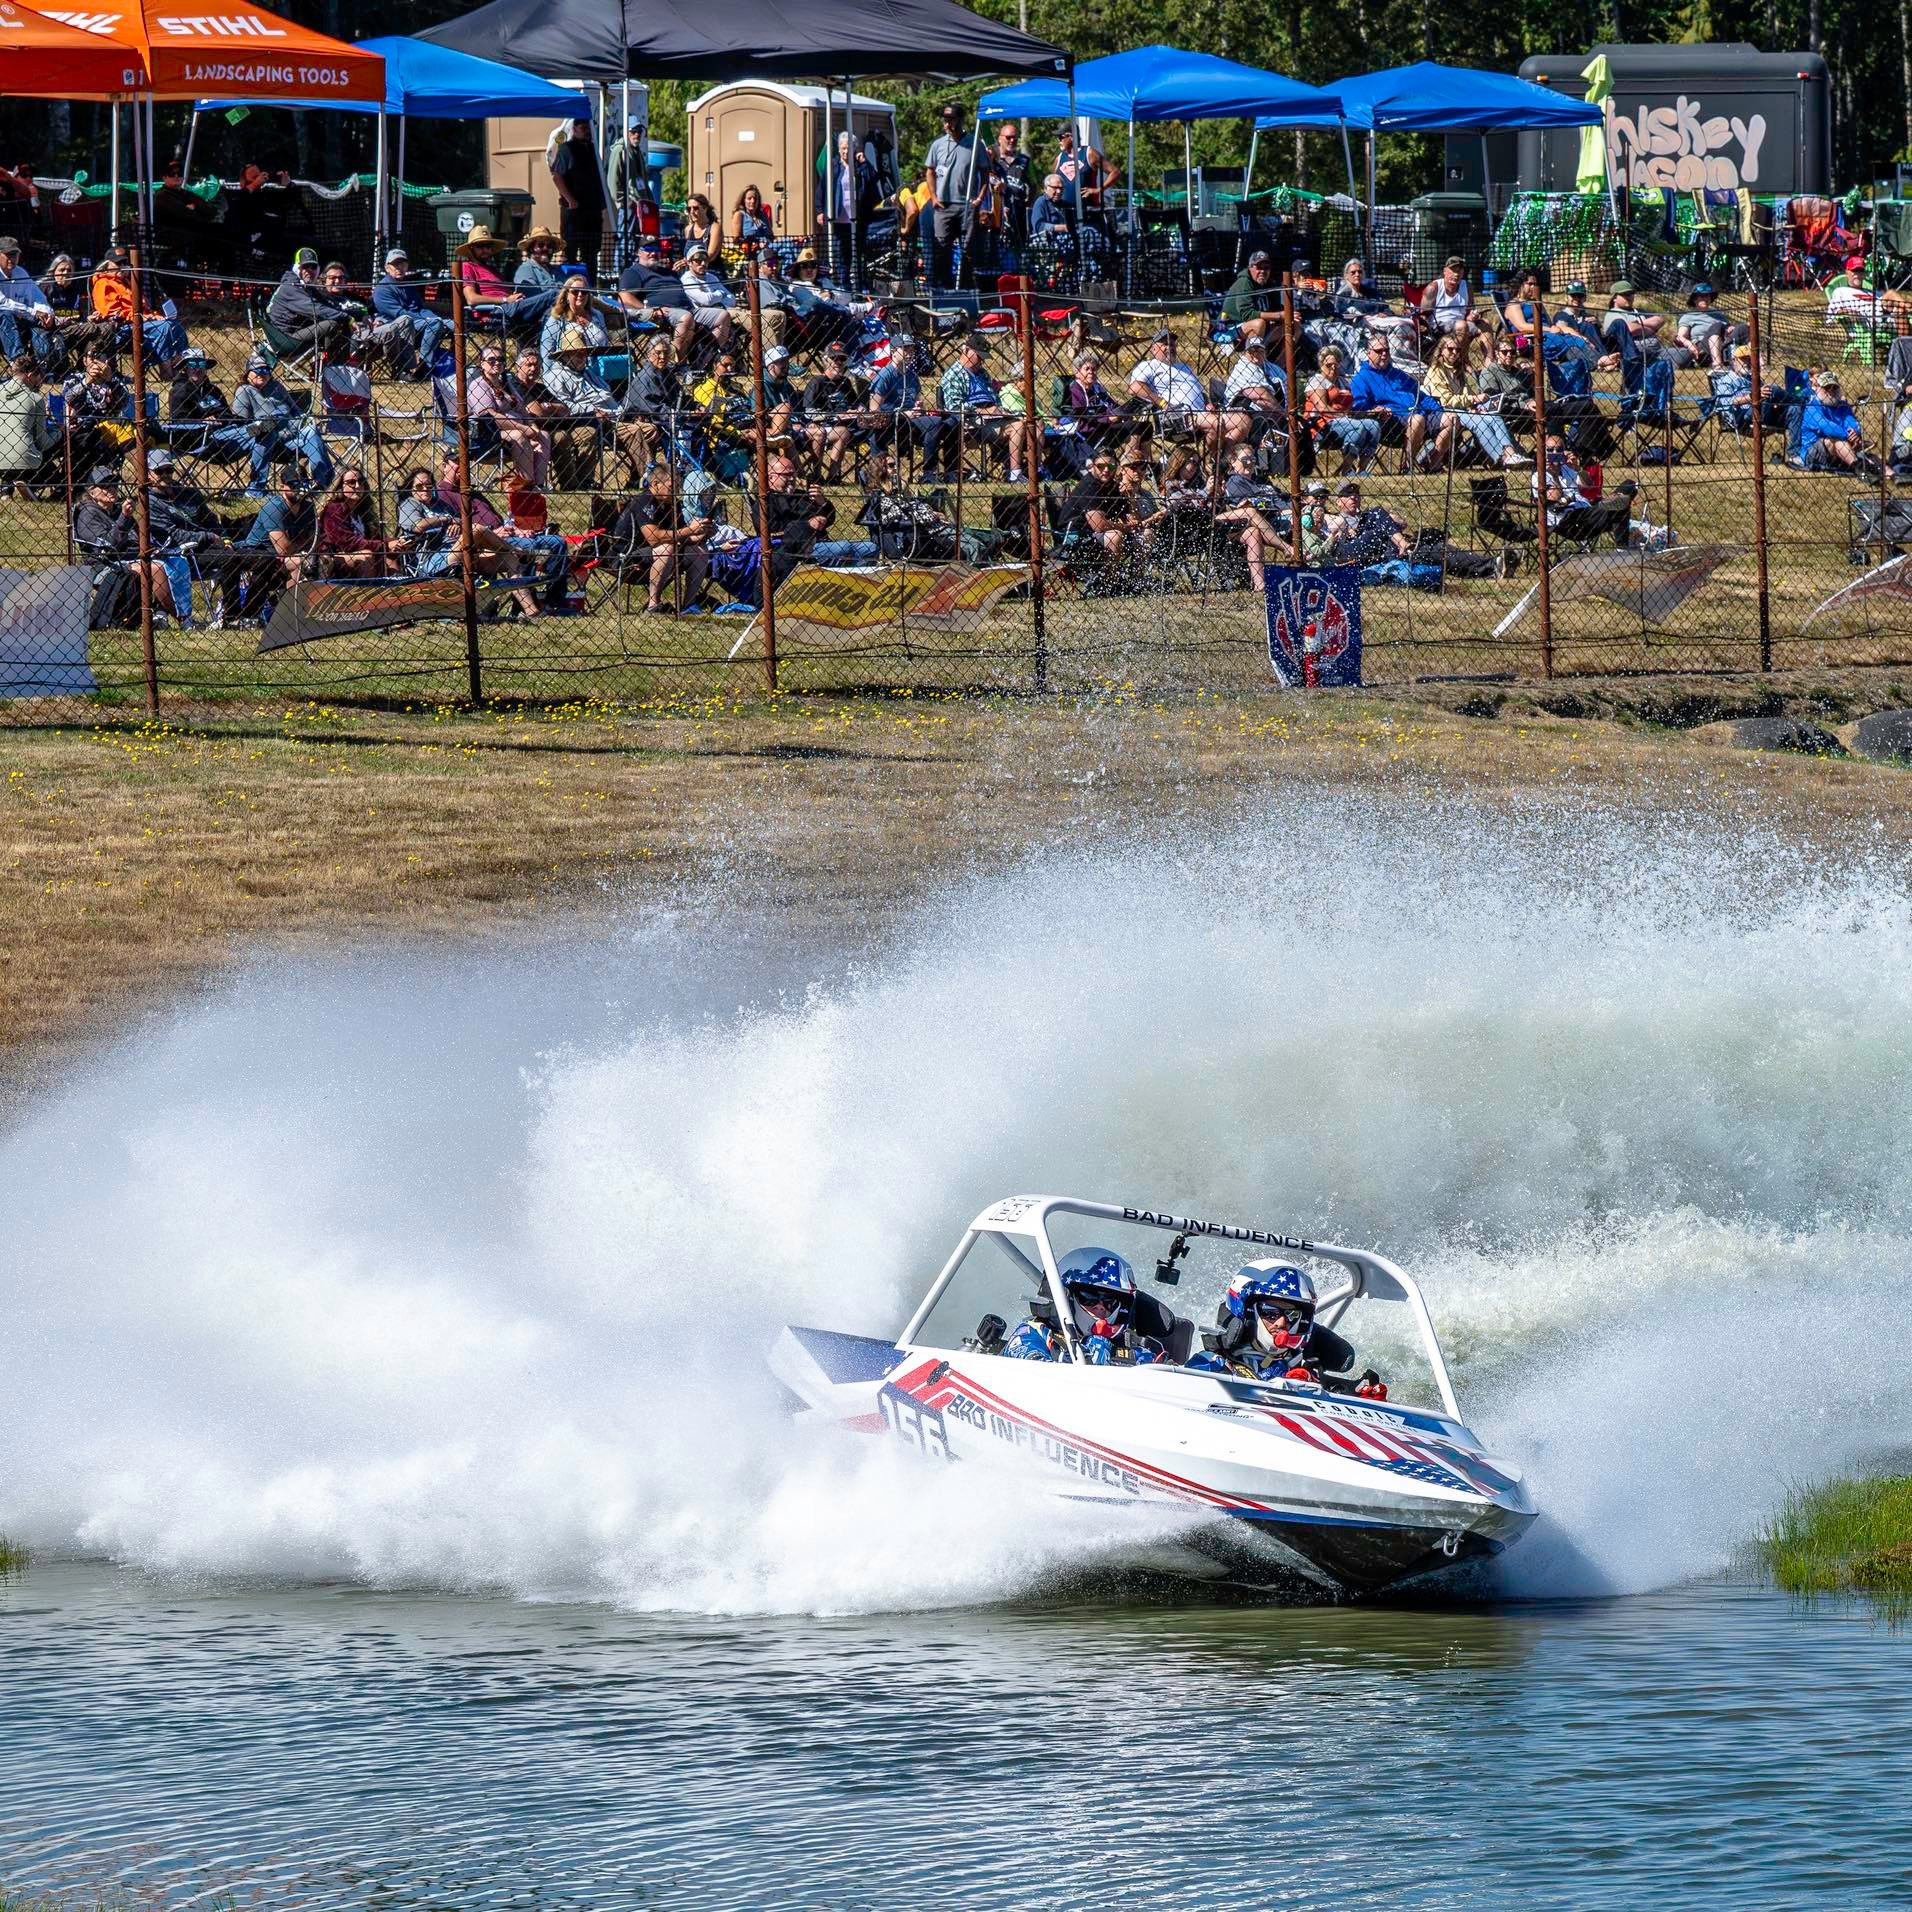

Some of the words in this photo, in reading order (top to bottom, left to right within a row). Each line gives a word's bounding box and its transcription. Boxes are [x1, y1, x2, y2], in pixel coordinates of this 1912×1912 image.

[157, 15, 287, 37] STIHL
[184, 64, 294, 83] LANDSCAPING
[299, 67, 350, 86] TOOLS
[1123, 1207, 1174, 1227] BAD
[1183, 1218, 1315, 1252] INFLUENCE
[1313, 1401, 1397, 1424] Cobalt
[947, 1394, 986, 1431] BAD
[990, 1414, 1140, 1496] INFLUENCE
